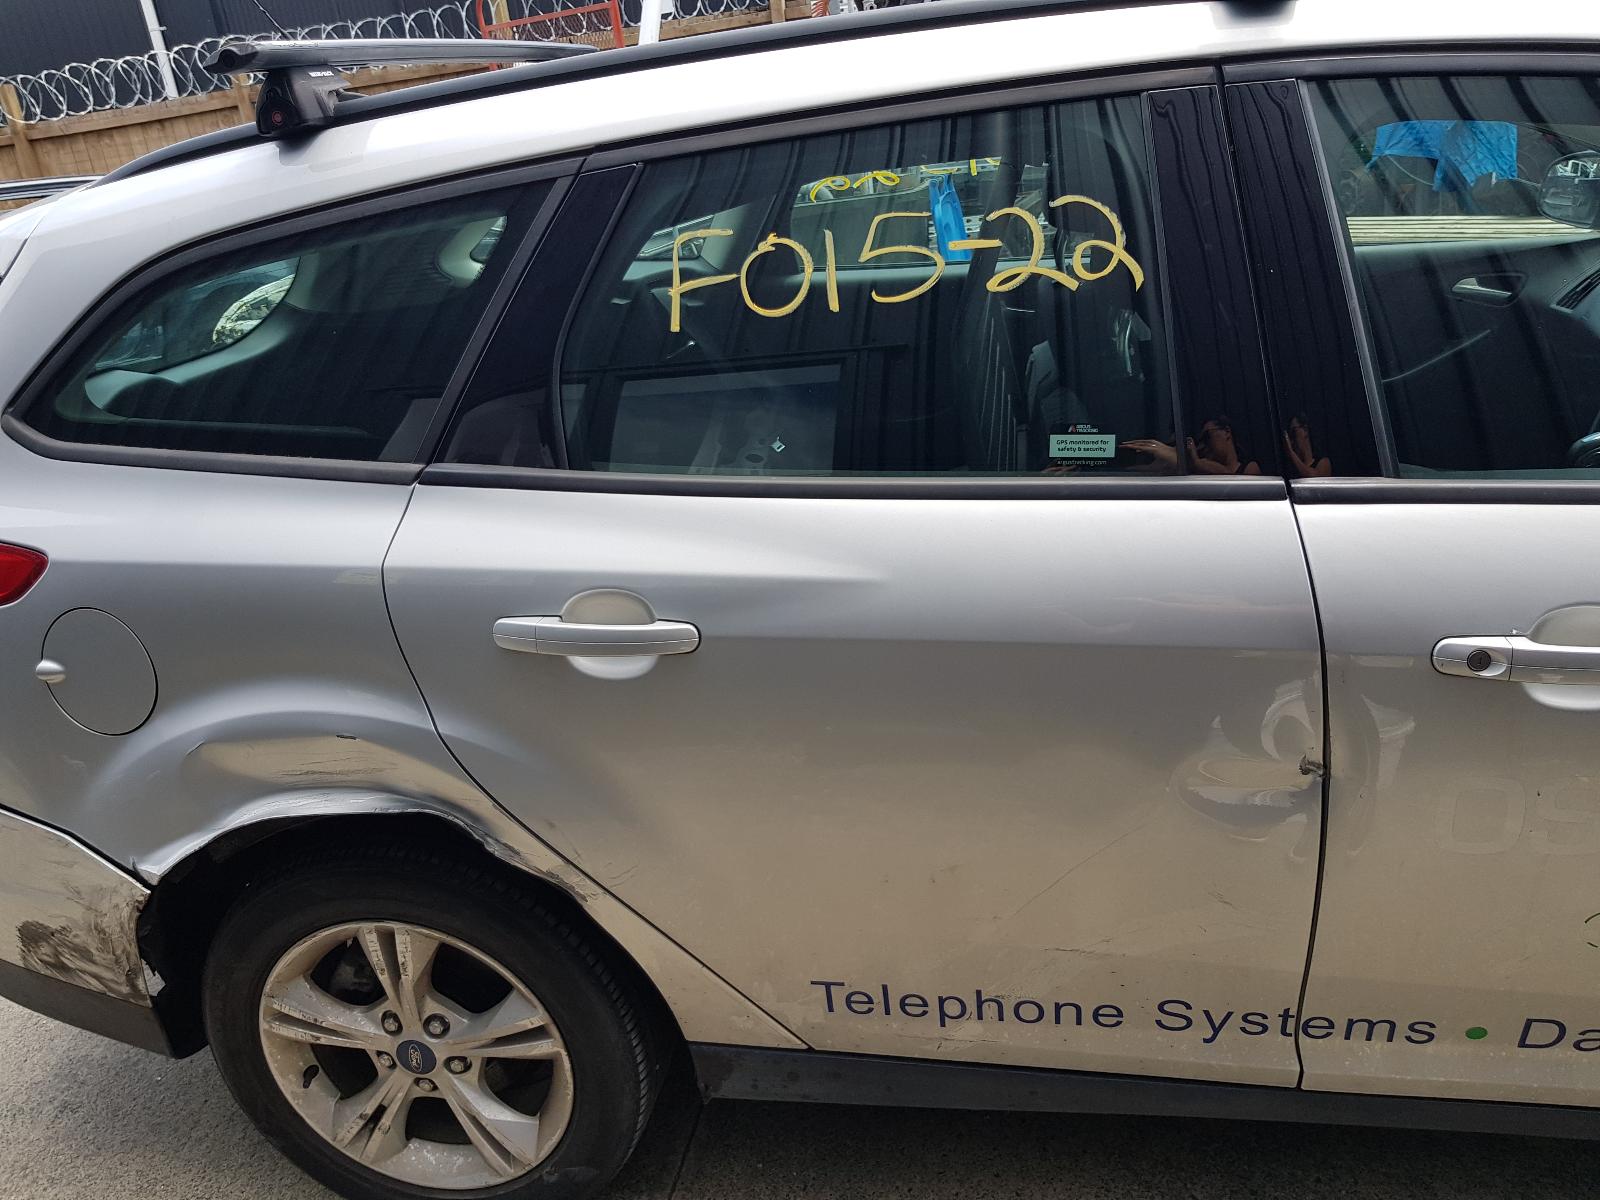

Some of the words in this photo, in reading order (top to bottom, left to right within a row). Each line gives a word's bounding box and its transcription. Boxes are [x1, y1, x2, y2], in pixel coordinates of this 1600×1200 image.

[669, 195, 1144, 332] F015-22
[810, 980, 1125, 1028] Telephone
[1154, 999, 1438, 1044] Systems
[1516, 1017, 1600, 1052] Da
